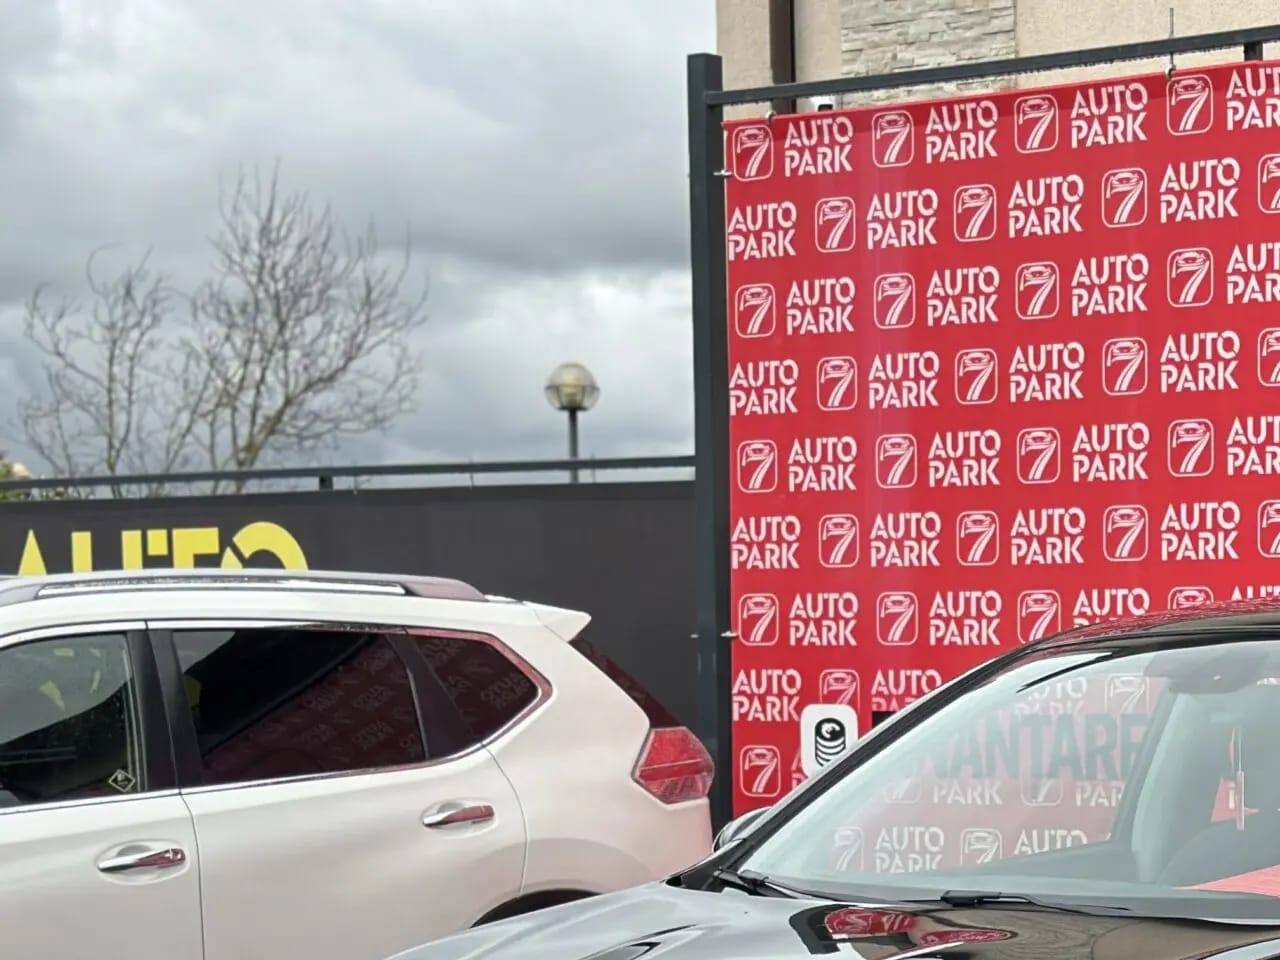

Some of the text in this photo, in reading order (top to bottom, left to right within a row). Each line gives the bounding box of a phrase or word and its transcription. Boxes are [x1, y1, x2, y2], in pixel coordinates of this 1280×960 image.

[1071, 83, 1147, 118] AUTO
[785, 116, 852, 148] AUTO
[926, 101, 997, 133] AUTO
[1072, 112, 1147, 148] PARK
[785, 145, 852, 177] PARK
[926, 129, 997, 163] PARK
[1160, 157, 1240, 193] AUTO
[866, 188, 938, 221] AUTO
[1008, 174, 1084, 209] AUTO
[1160, 188, 1239, 223] PARK
[726, 201, 797, 234] AUTO
[1009, 203, 1083, 238] PARK
[726, 229, 796, 260] PARK
[867, 217, 937, 250] PARK
[927, 265, 1000, 297] AUTO
[1071, 253, 1149, 287] AUTO
[786, 277, 855, 307] AUTO
[1072, 282, 1148, 317] PARK
[787, 305, 854, 335] PARK
[927, 294, 998, 326] PARK
[1009, 341, 1085, 373] AUTO
[1160, 330, 1240, 363] AUTO
[729, 359, 799, 388] AUTO
[868, 351, 939, 382] AUTO
[1161, 360, 1239, 393] PARK
[730, 387, 798, 416] PARK
[869, 379, 938, 410] PARK
[1010, 370, 1084, 403] PARK
[788, 436, 857, 464] AUTO
[928, 429, 1001, 459] AUTO
[1072, 422, 1150, 453] AUTO
[789, 463, 856, 492] PARK
[929, 458, 1000, 487] PARK
[1073, 451, 1148, 482] PARK
[731, 515, 801, 542] AUTO
[870, 511, 941, 540] AUTO
[1010, 507, 1086, 536] AUTO
[1160, 501, 1240, 531] AUTO
[731, 542, 800, 572] PARK
[870, 539, 940, 567] PARK
[1011, 536, 1084, 565] PARK
[1161, 531, 1238, 561] PARK
[789, 592, 858, 620] AUTO
[929, 590, 1001, 617] AUTO
[1072, 589, 1150, 617] AUTO
[790, 619, 856, 646] PARK
[930, 619, 1000, 645] PARK
[732, 669, 801, 695] AUTO
[871, 669, 941, 697] AUTO
[732, 695, 800, 722] PARK
[874, 826, 945, 852] AUTO
